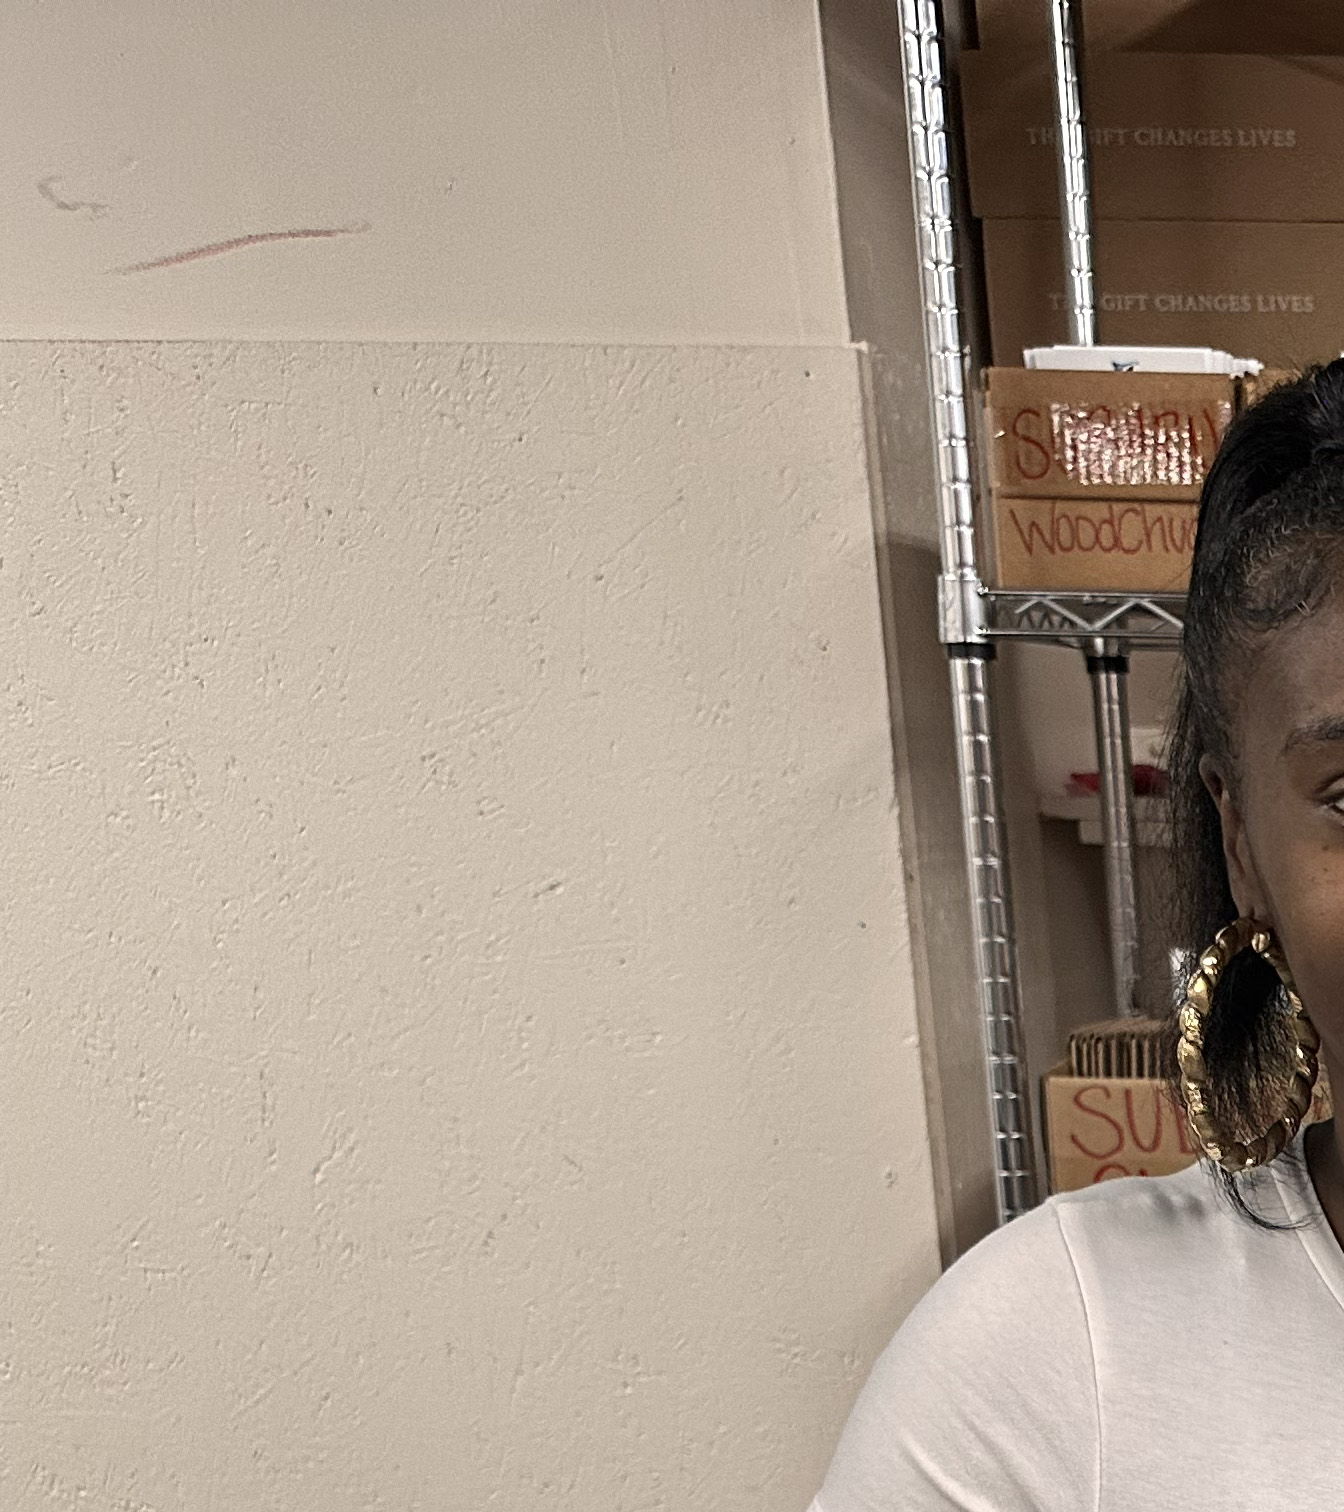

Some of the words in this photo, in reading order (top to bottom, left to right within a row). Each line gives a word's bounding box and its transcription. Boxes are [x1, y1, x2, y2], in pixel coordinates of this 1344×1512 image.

[1134, 128, 1234, 147] CHANGES
[1239, 129, 1297, 148] LIVES
[1102, 295, 1148, 312] GIFT
[1153, 295, 1252, 312] CHANGES
[1257, 295, 1315, 313] LIVES
